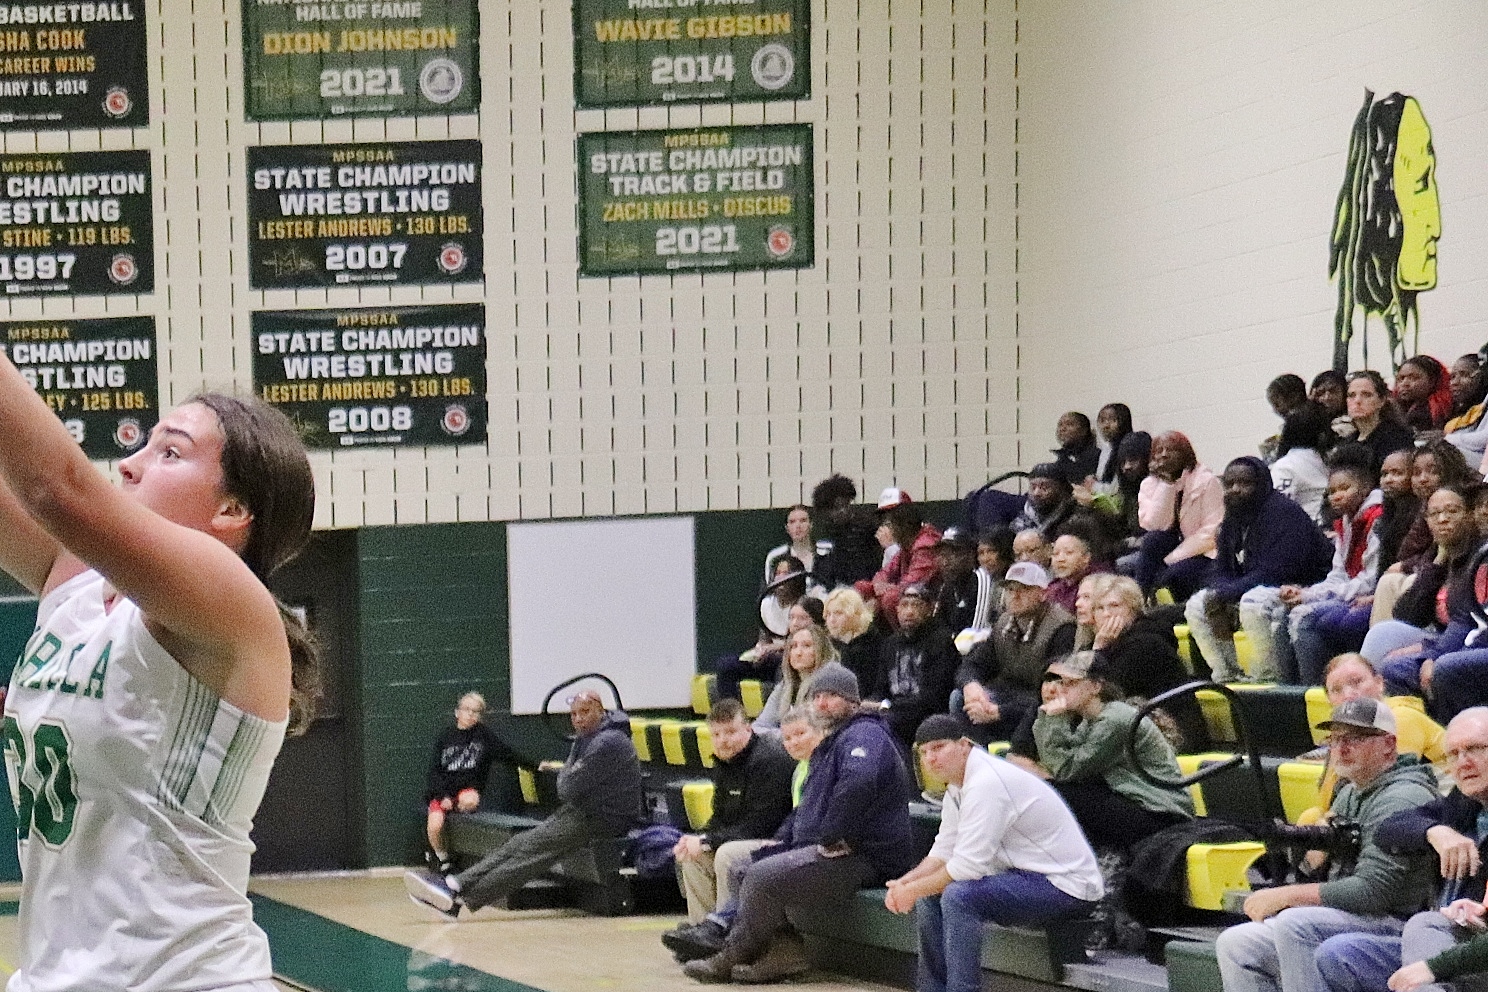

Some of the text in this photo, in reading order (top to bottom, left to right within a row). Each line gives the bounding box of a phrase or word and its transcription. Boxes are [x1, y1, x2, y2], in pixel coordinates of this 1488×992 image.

[296, 2, 422, 21] HALL OF FAME
[35, 29, 86, 50] COOK
[595, 12, 791, 42] WAVIE GIBSON
[264, 27, 457, 54] DION JOHNSON
[55, 55, 96, 73] WINS
[651, 53, 735, 85] 2014
[55, 79, 89, 95] 2014
[320, 67, 404, 98] 2021
[2, 160, 64, 173] MPSSAA
[333, 150, 395, 163] MPSSAA
[590, 146, 803, 174] STATE CHAMPION
[7, 173, 145, 198] CHAMPION
[254, 163, 475, 190] STATE CHAMPION
[609, 174, 688, 197] TRACK
[716, 170, 784, 192] FIELD
[279, 189, 450, 216] WRESTLING
[603, 196, 792, 222] ZACH MILLS DISCUS
[3, 228, 52, 247] STINE
[68, 227, 96, 246] 119
[259, 219, 314, 240] LESTER
[318, 218, 392, 238] ANDREWS
[407, 217, 435, 236] 130
[656, 224, 739, 255] 2021
[325, 244, 407, 271] 2007
[337, 313, 398, 327] MPSSAA
[8, 326, 70, 340] MPSSAA
[259, 326, 479, 354] STATE CHAMPION
[13, 340, 151, 364] CHAMPION
[283, 351, 454, 380] WRESTLING
[82, 392, 111, 411] 125
[263, 382, 318, 404] LESTER
[322, 381, 396, 401] ANDREWS
[411, 380, 438, 398] 130
[328, 406, 412, 433] 2008
